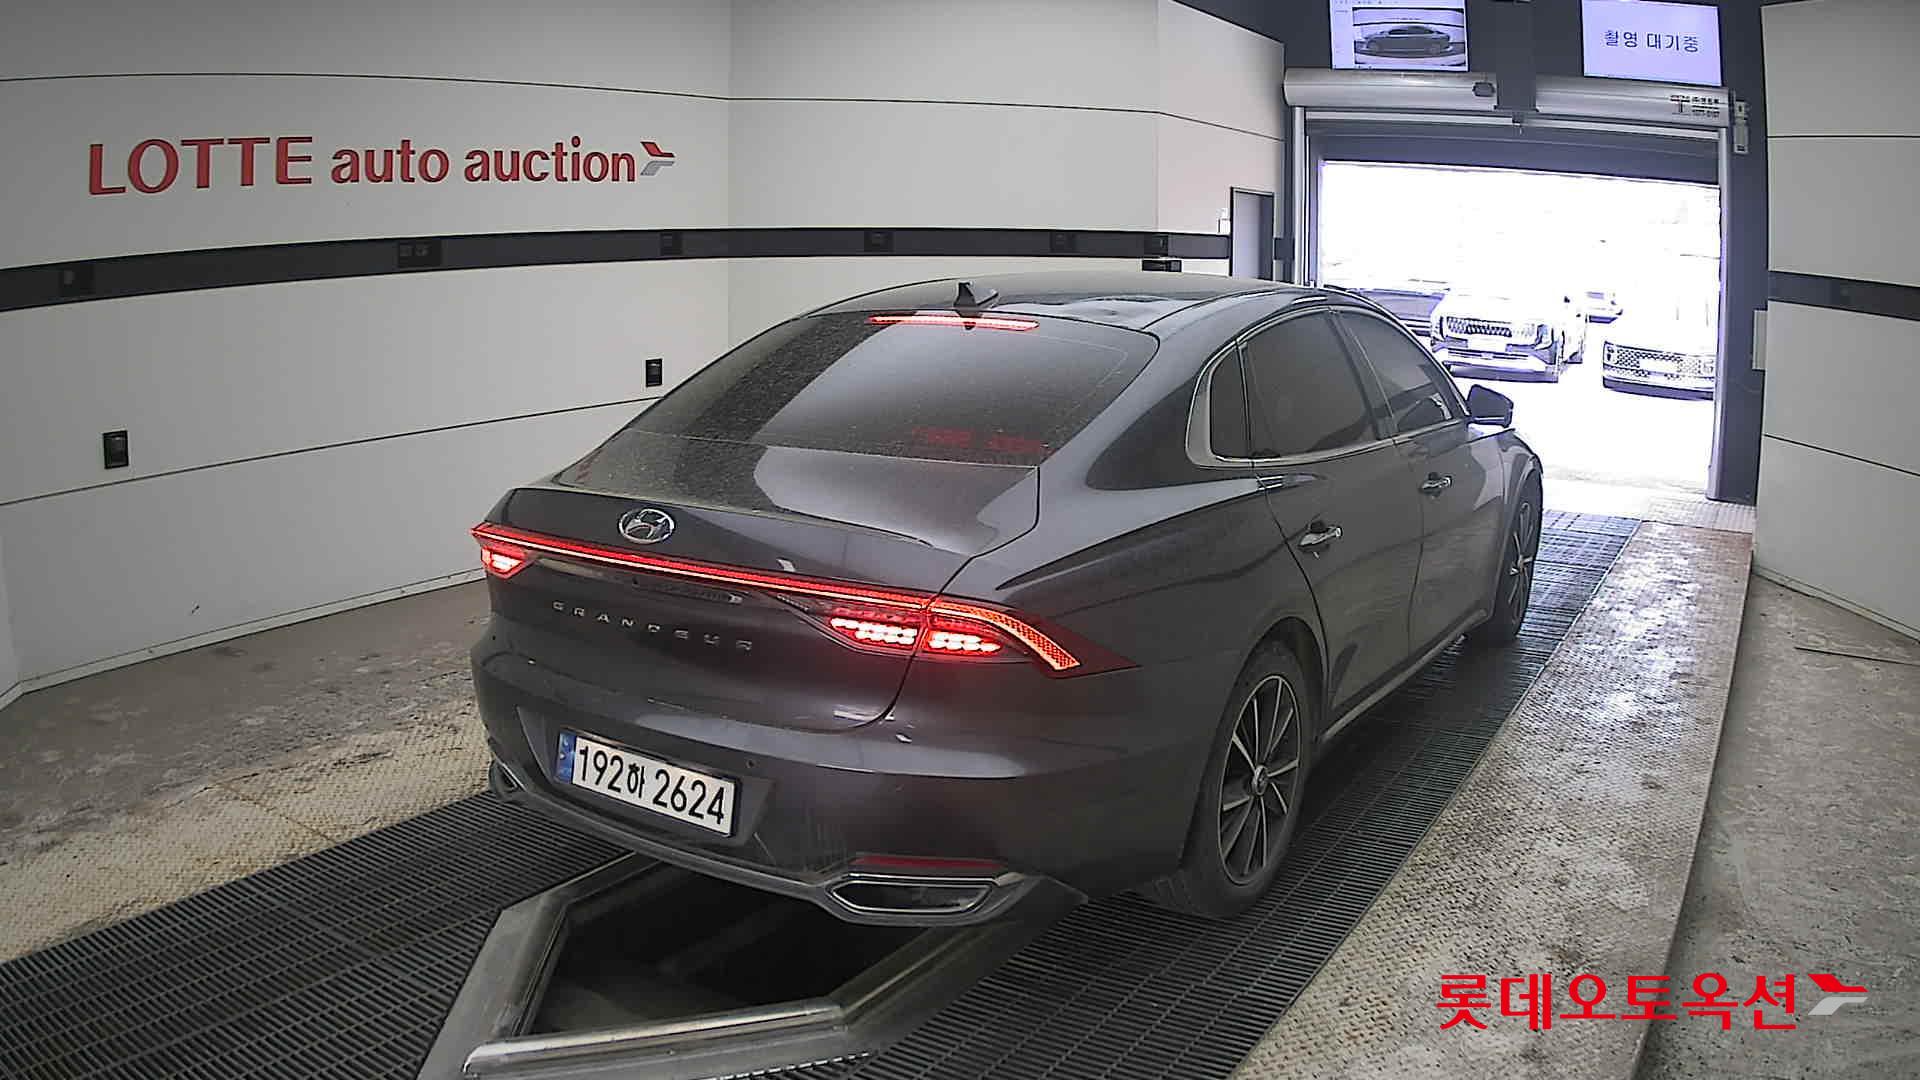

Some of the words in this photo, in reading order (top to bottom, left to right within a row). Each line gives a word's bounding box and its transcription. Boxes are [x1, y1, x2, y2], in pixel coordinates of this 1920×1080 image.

[1646, 33, 1698, 53] 대기중
[88, 135, 313, 196] LOTTE
[330, 139, 450, 184] auto
[463, 135, 637, 183] auction
[552, 599, 753, 652] GRANDEUR
[651, 768, 725, 826] 2624
